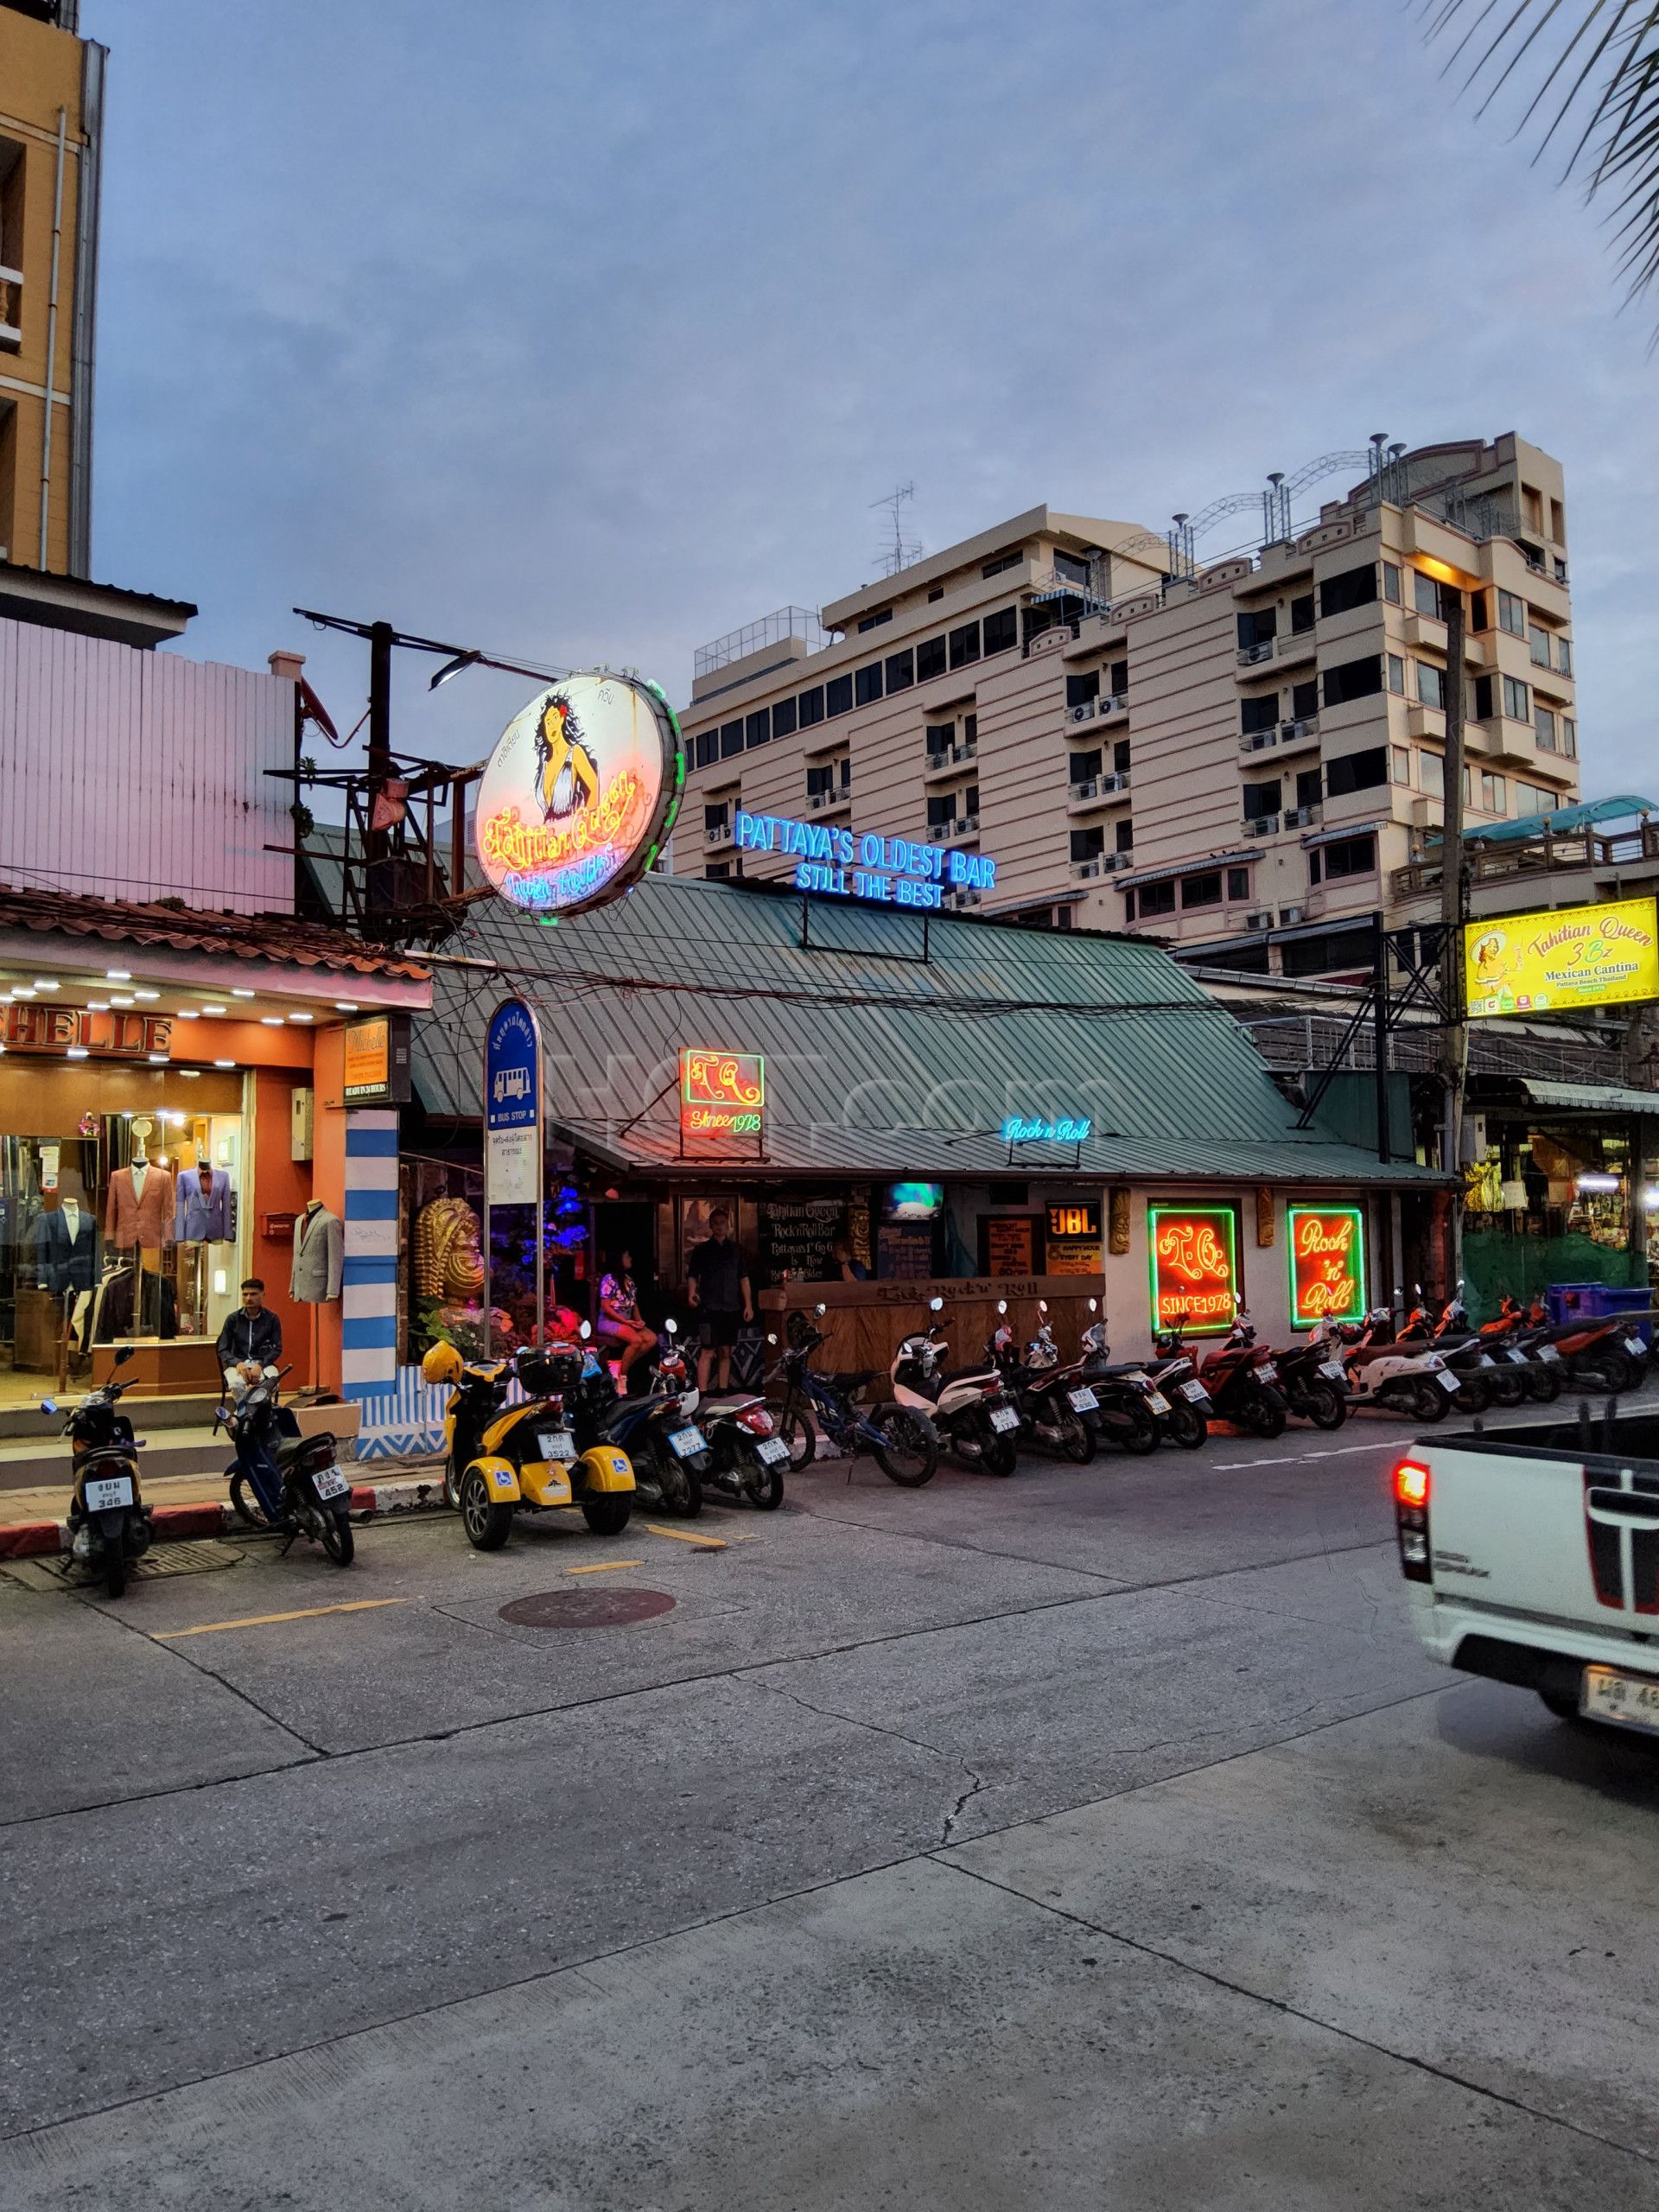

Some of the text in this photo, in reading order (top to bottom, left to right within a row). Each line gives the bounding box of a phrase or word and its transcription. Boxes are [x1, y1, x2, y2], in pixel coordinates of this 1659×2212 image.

[483, 771, 636, 870] Tahitian Queen
[736, 810, 996, 889] PATTAYA'S OLDEST BAR
[797, 863, 945, 908] STILL THE BEST
[1528, 916, 1654, 958] Tahitian Queen
[1544, 961, 1638, 982] Mexican Cantina
[1555, 974, 1627, 988] Pattaya Beach Thailand
[0, 1006, 171, 1052] HELLE
[498, 1110, 526, 1122] BUS STOP
[1006, 1118, 1044, 1140] Rock
[1057, 1120, 1091, 1141] Roll
[766, 1202, 840, 1223] Tahitian Queen
[1051, 1208, 1097, 1234] JBL
[818, 1223, 836, 1236] Bar
[1300, 1219, 1353, 1256] Rock
[998, 1281, 1039, 1297] Roll
[1302, 1280, 1355, 1314] Roll
[682, 1442, 701, 1456] 7277
[325, 1484, 345, 1497] 452
[99, 1497, 121, 1508] 346
